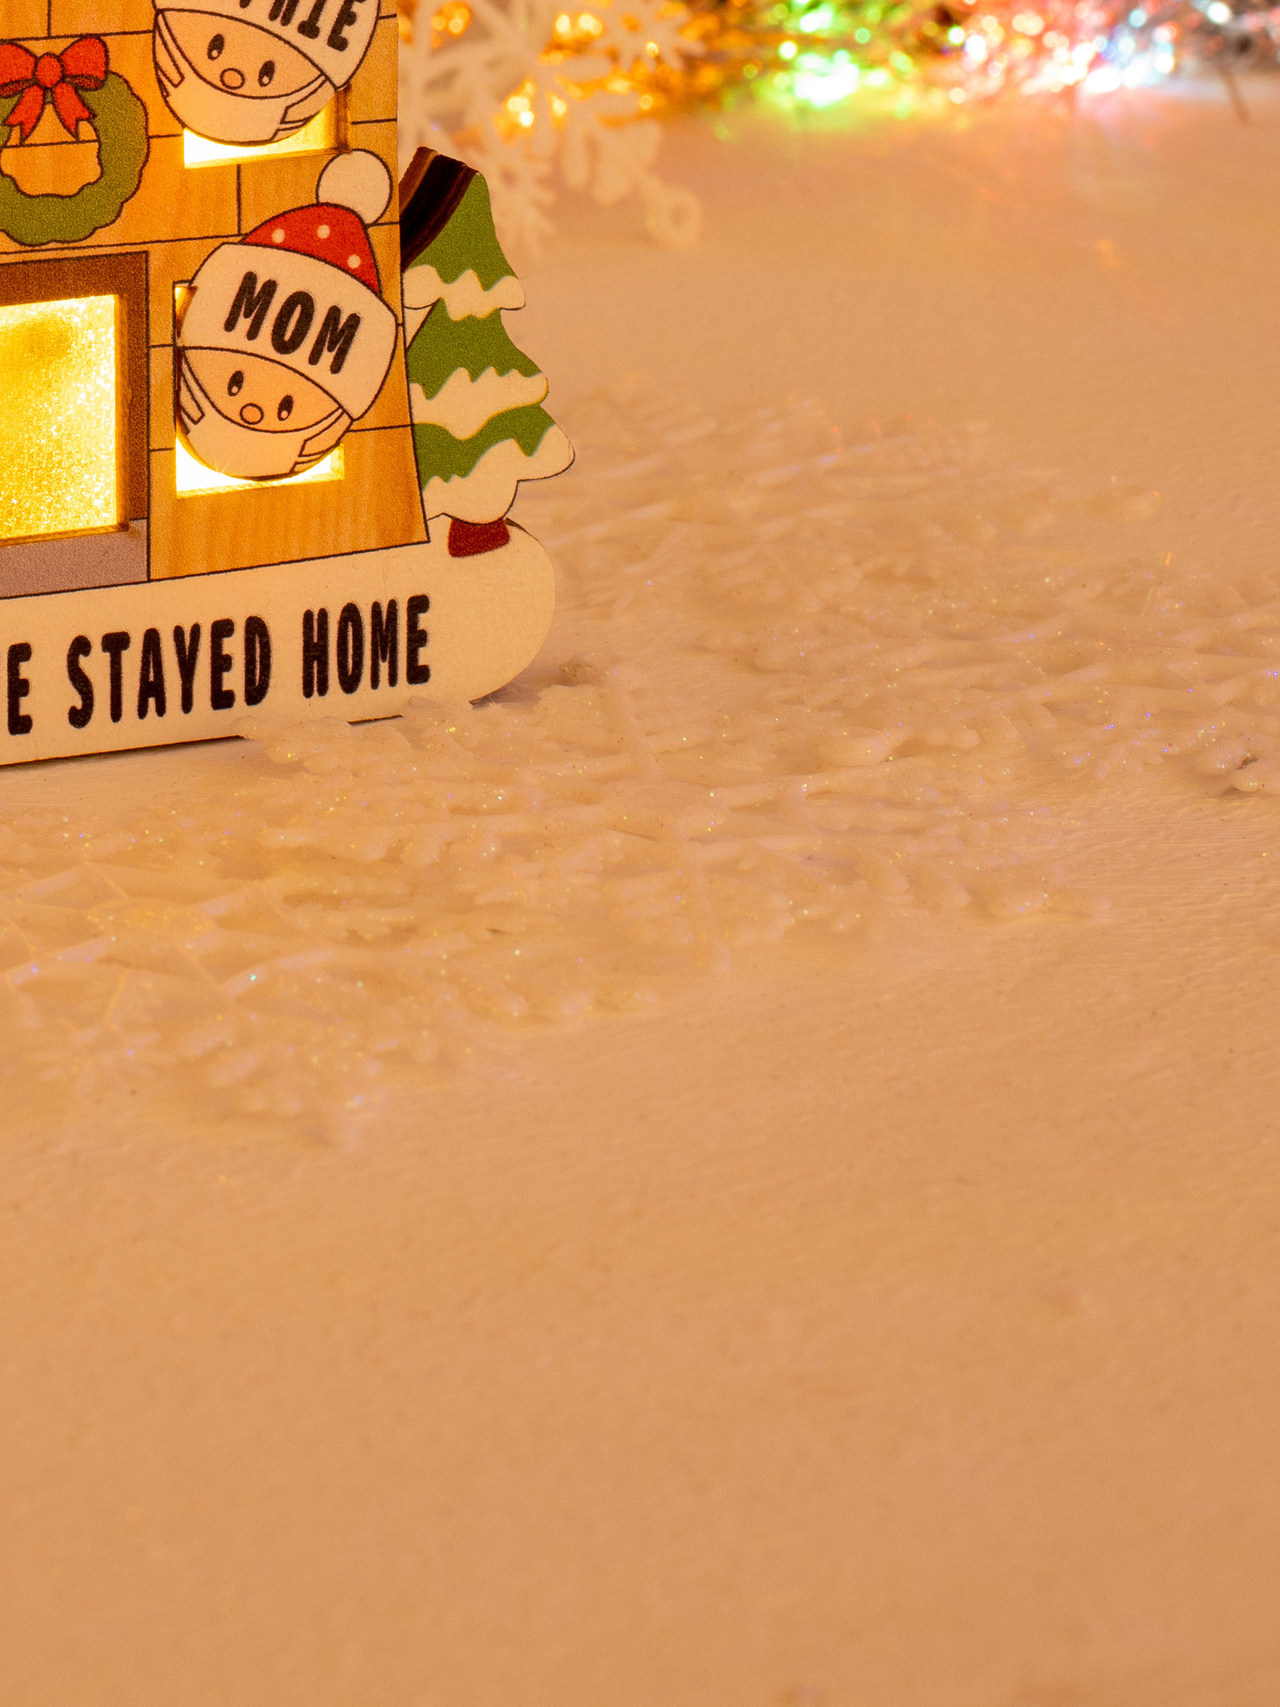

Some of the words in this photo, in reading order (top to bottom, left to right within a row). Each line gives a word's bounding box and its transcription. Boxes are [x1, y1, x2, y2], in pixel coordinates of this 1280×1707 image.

[223, 270, 362, 376] MOM
[67, 616, 272, 730] STAYED
[302, 594, 431, 700] HOME
